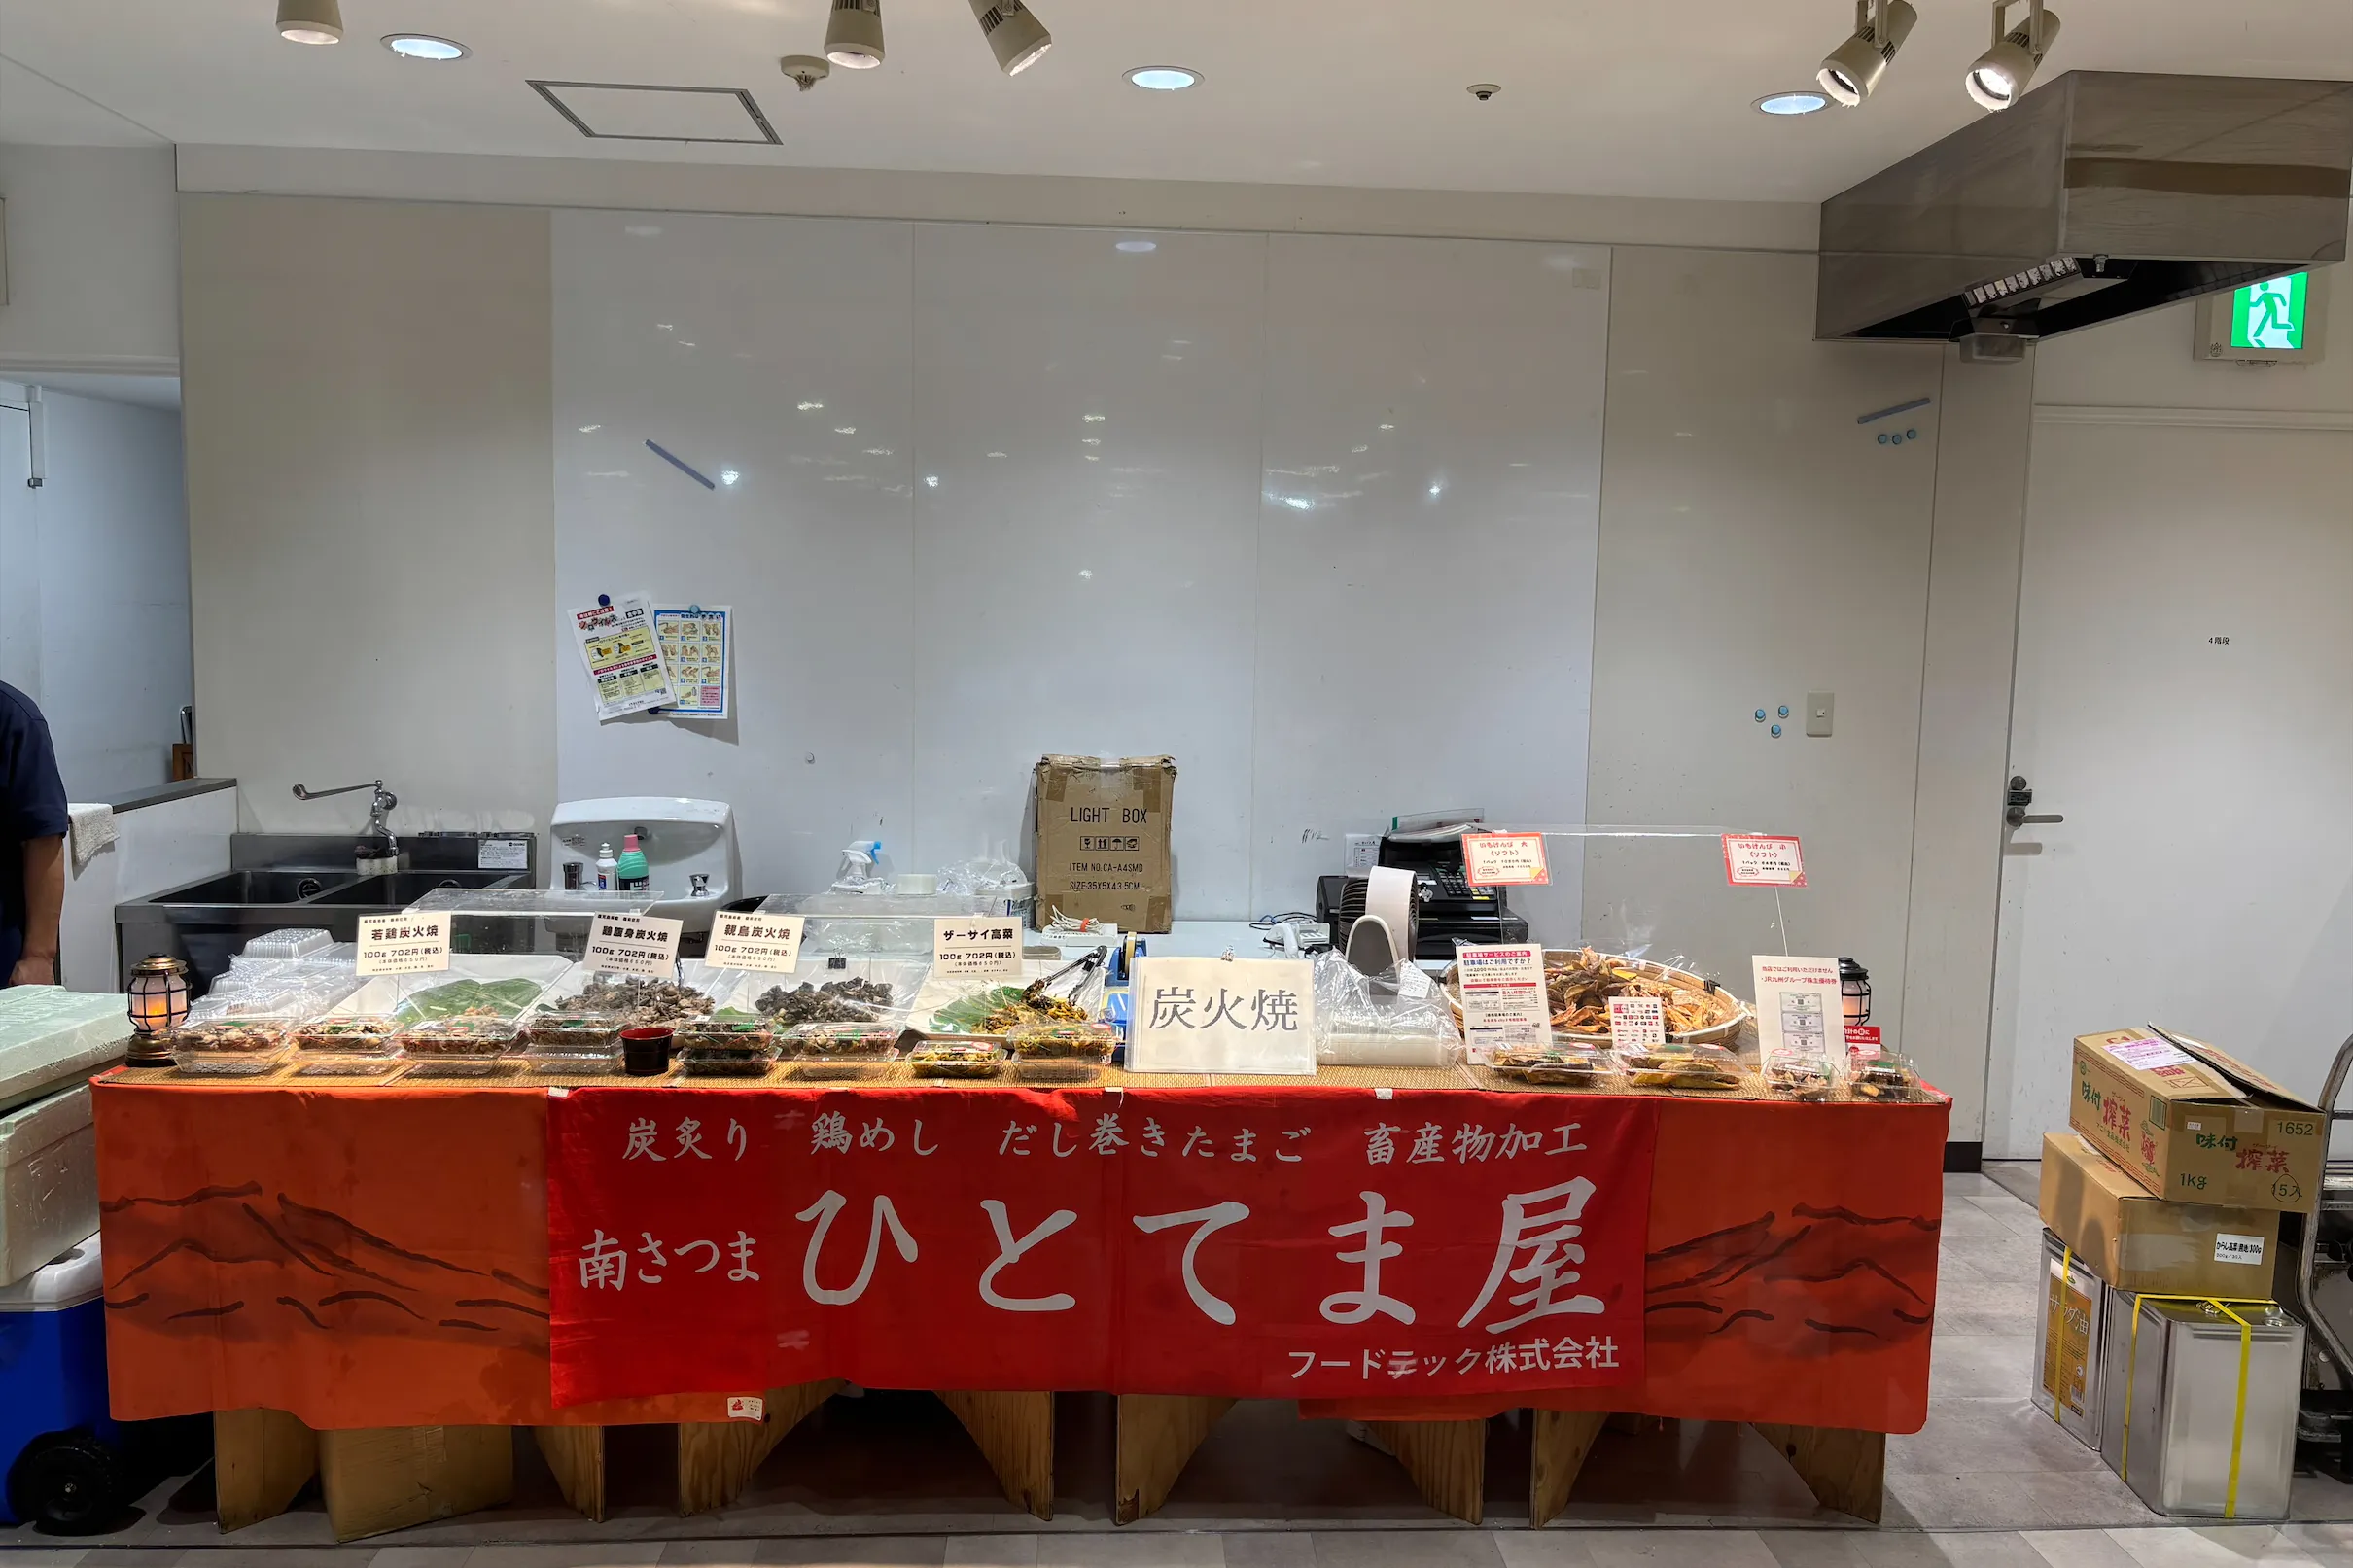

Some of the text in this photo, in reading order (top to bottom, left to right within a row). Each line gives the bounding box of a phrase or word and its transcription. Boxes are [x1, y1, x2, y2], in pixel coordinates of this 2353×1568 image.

[2209, 636, 2229, 645] 4階段
[1071, 807, 1147, 824] LIGHT BOX
[1070, 863, 1088, 871] ITEM
[1070, 881, 1140, 890] SIZE:35X5X43.5CM
[372, 925, 438, 940] 若鶏炭火焼
[943, 929, 1013, 941] ザーサイ高菜
[391, 947, 443, 956] 702円(税込)
[592, 946, 669, 960] 100g 702円(税込)
[741, 946, 792, 956] 702円(税込)
[1762, 966, 1833, 974] 当店ではご利用いただけません
[1149, 986, 1298, 1031] 炭火焼
[2082, 1080, 2100, 1111] 味付
[2277, 1121, 2314, 1136] 1652
[622, 1111, 1588, 1165] 炭炙り 鶏めし だし巻きたまご 畜産物加工
[2196, 1132, 2238, 1151] 味付
[2180, 1173, 2207, 1190] 1kg
[579, 1176, 1606, 1334] 南さつま ひとてま屋
[1288, 1335, 1619, 1380] フードテック株式会社
